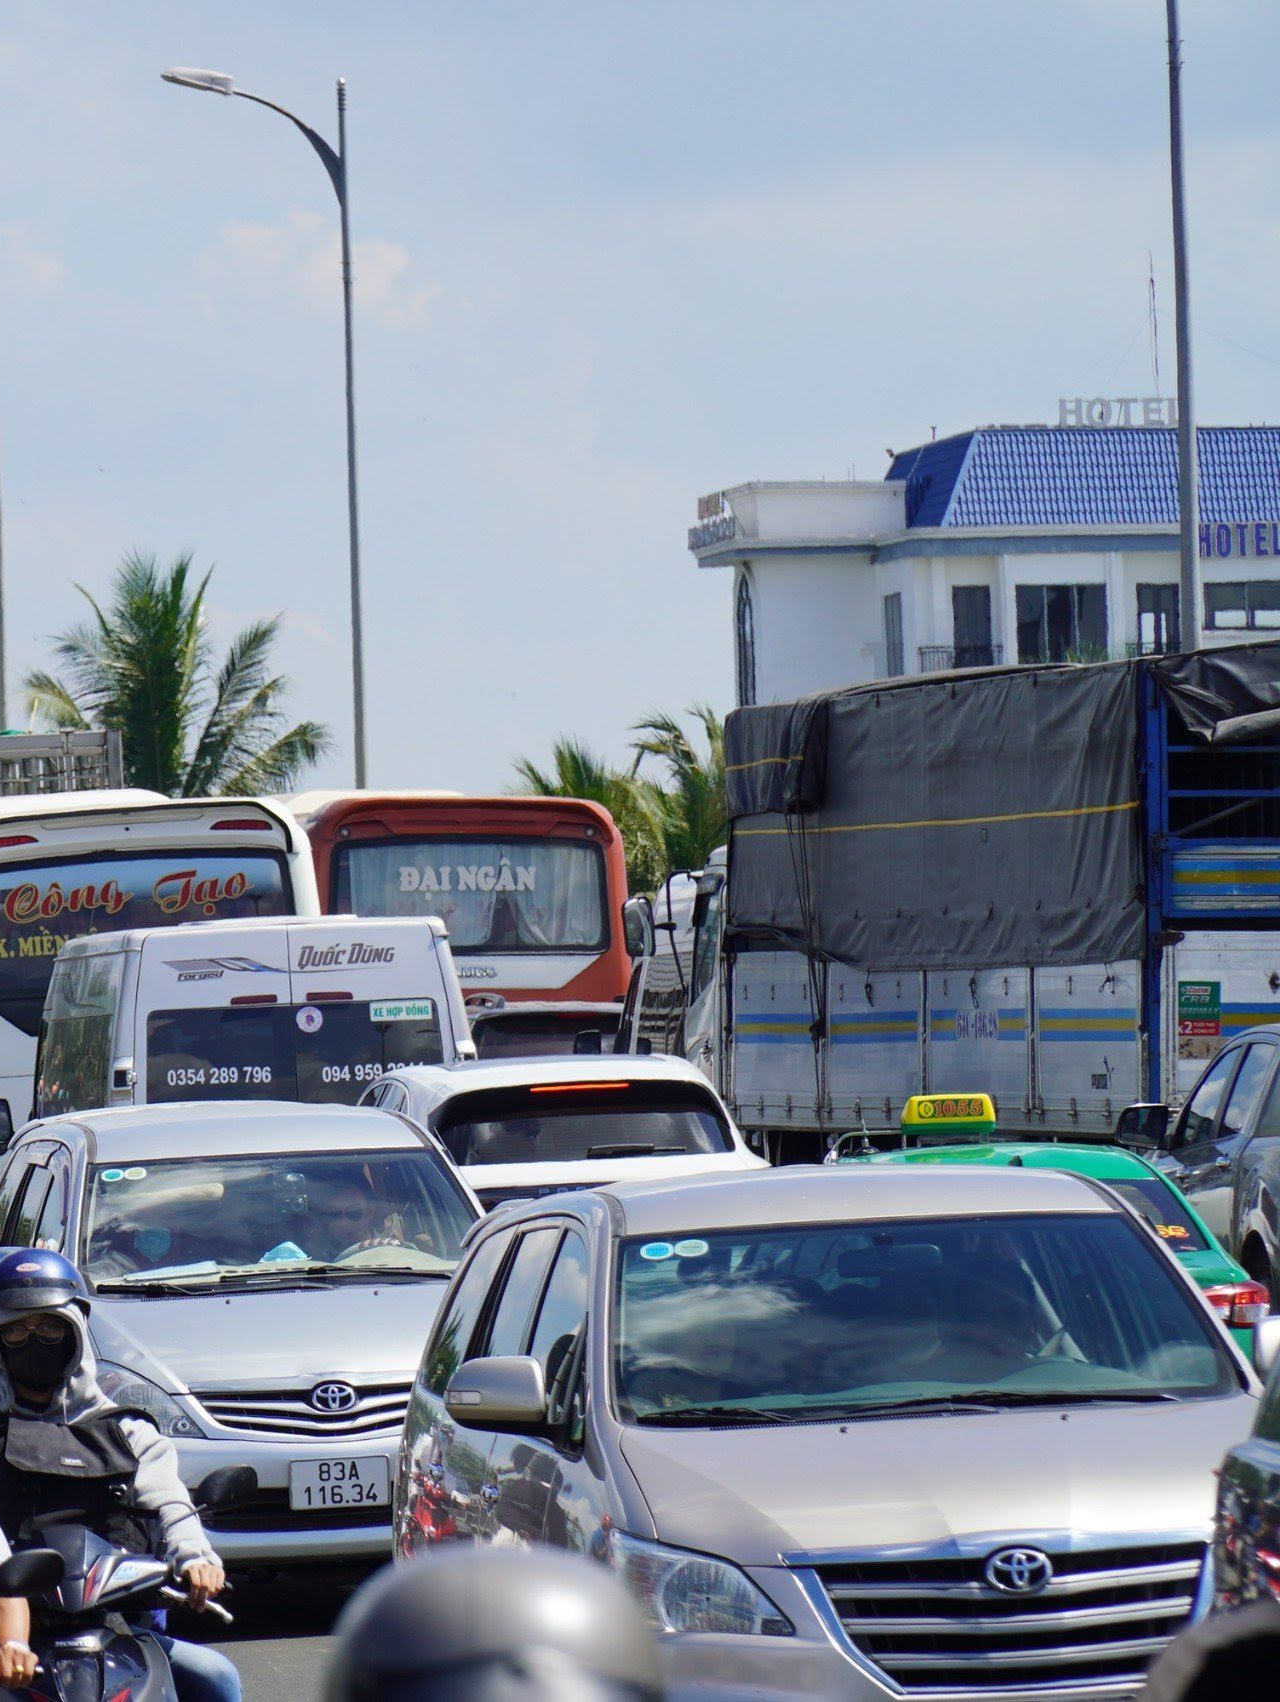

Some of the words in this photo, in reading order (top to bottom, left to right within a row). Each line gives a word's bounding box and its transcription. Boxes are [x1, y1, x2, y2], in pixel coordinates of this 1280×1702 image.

[1058, 397, 1179, 428] HOTEL
[1198, 522, 1280, 559] HOTEL
[399, 866, 452, 900] ĐẠI
[457, 857, 537, 892] NGÂN
[4, 880, 133, 924] Công
[153, 870, 254, 915] Tạo
[1180, 1006, 1220, 1015] RBOMAX
[1181, 995, 1210, 1004] CRB
[167, 1068, 206, 1087] 0354
[210, 1068, 239, 1084] 289
[243, 1066, 272, 1084] 796
[322, 1064, 351, 1083] 094
[355, 1062, 383, 1081] 959
[934, 1099, 984, 1117] 1055
[318, 1460, 360, 1482] 83A
[304, 1482, 378, 1506] 116.34
